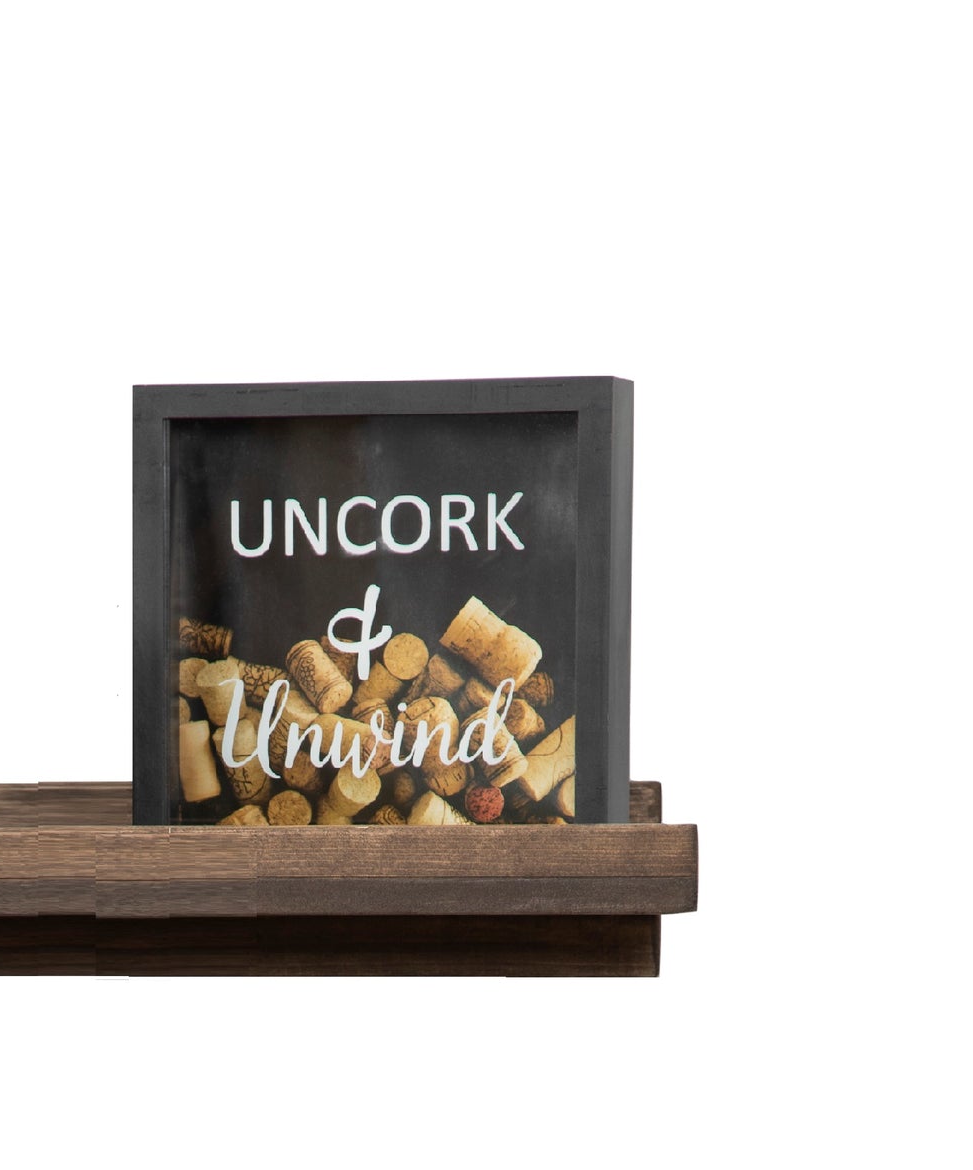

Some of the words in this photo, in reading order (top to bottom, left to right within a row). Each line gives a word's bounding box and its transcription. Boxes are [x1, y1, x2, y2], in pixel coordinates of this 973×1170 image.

[230, 491, 525, 558] UNCORK
[327, 584, 393, 681] &
[218, 677, 516, 779] Unwind
